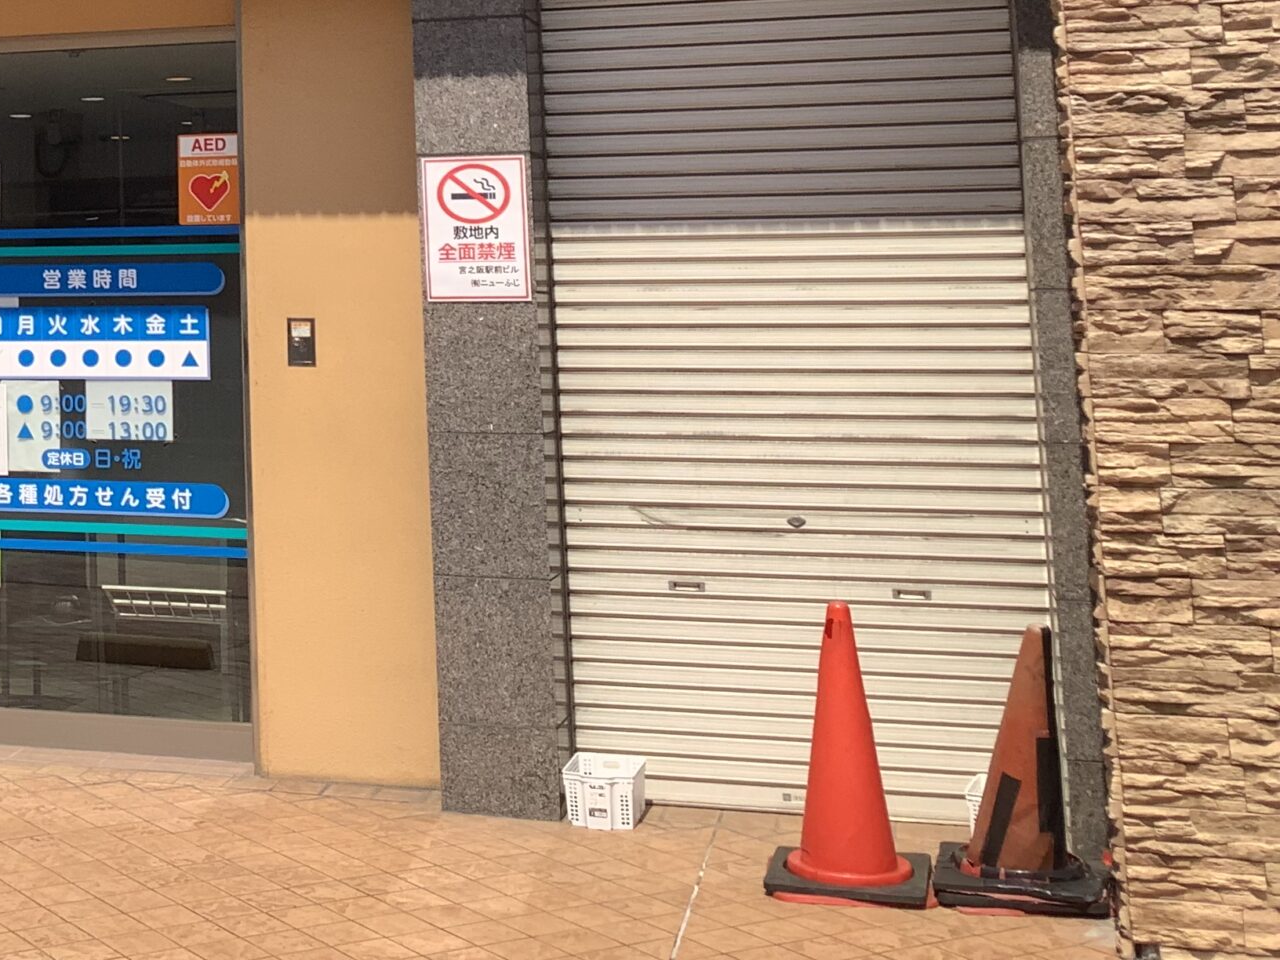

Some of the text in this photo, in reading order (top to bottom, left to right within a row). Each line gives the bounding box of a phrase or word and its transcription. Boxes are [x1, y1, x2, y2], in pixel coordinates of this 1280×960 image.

[192, 137, 226, 152] AED
[453, 225, 499, 240] 敷地内
[438, 242, 516, 261] 全面禁煙
[42, 268, 138, 290] 営業時間
[40, 395, 166, 415] 9:00 19:30
[41, 421, 167, 441] 9:00 13:00
[47, 451, 84, 466] 定休日
